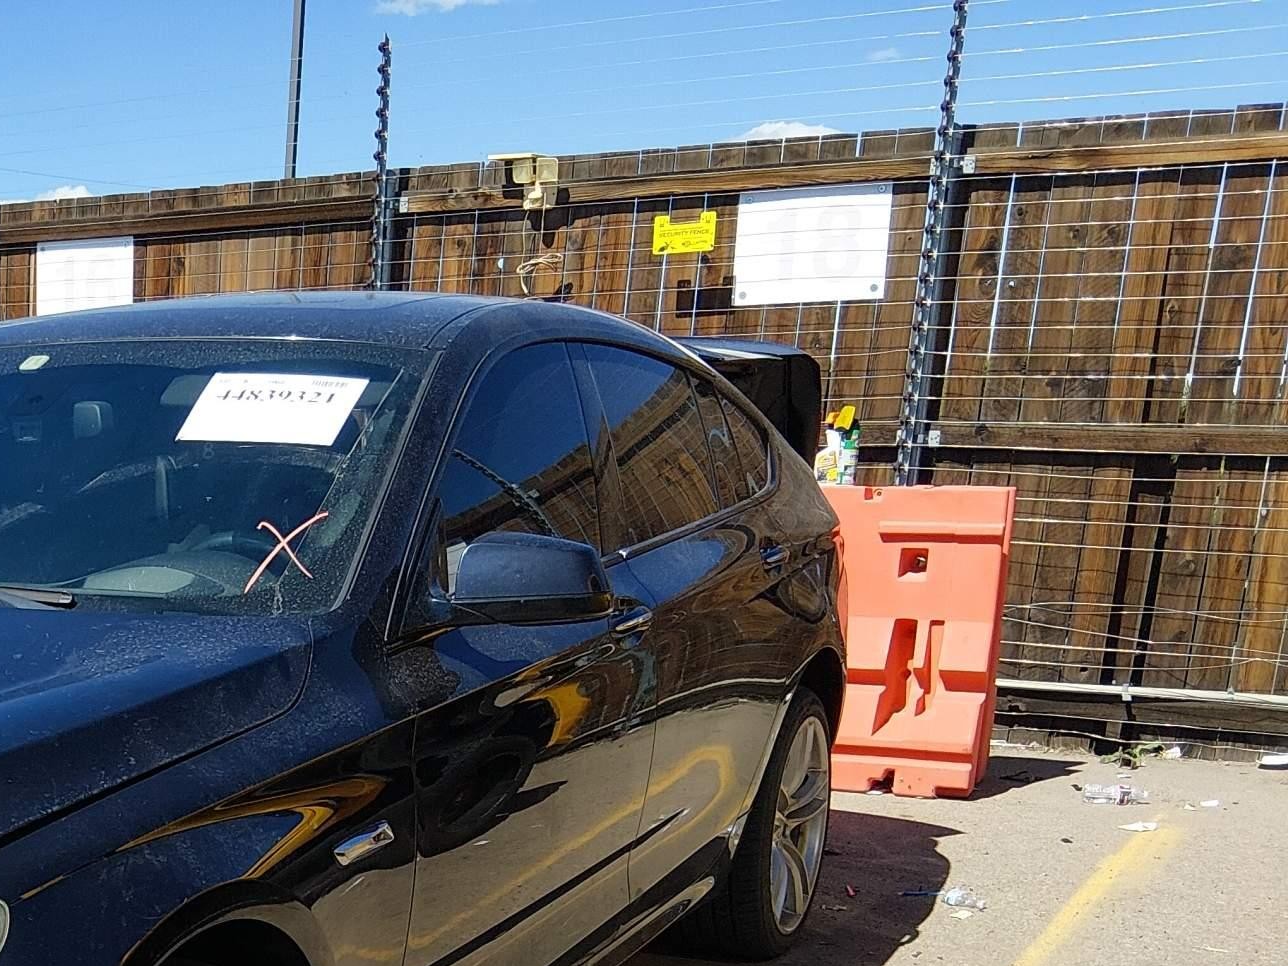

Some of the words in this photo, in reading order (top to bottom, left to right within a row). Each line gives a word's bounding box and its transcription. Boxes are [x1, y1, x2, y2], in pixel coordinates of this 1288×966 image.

[659, 230, 689, 239] SECURITY
[690, 228, 710, 236] FENCE
[767, 204, 862, 283] 18
[216, 389, 336, 404] 44839321
